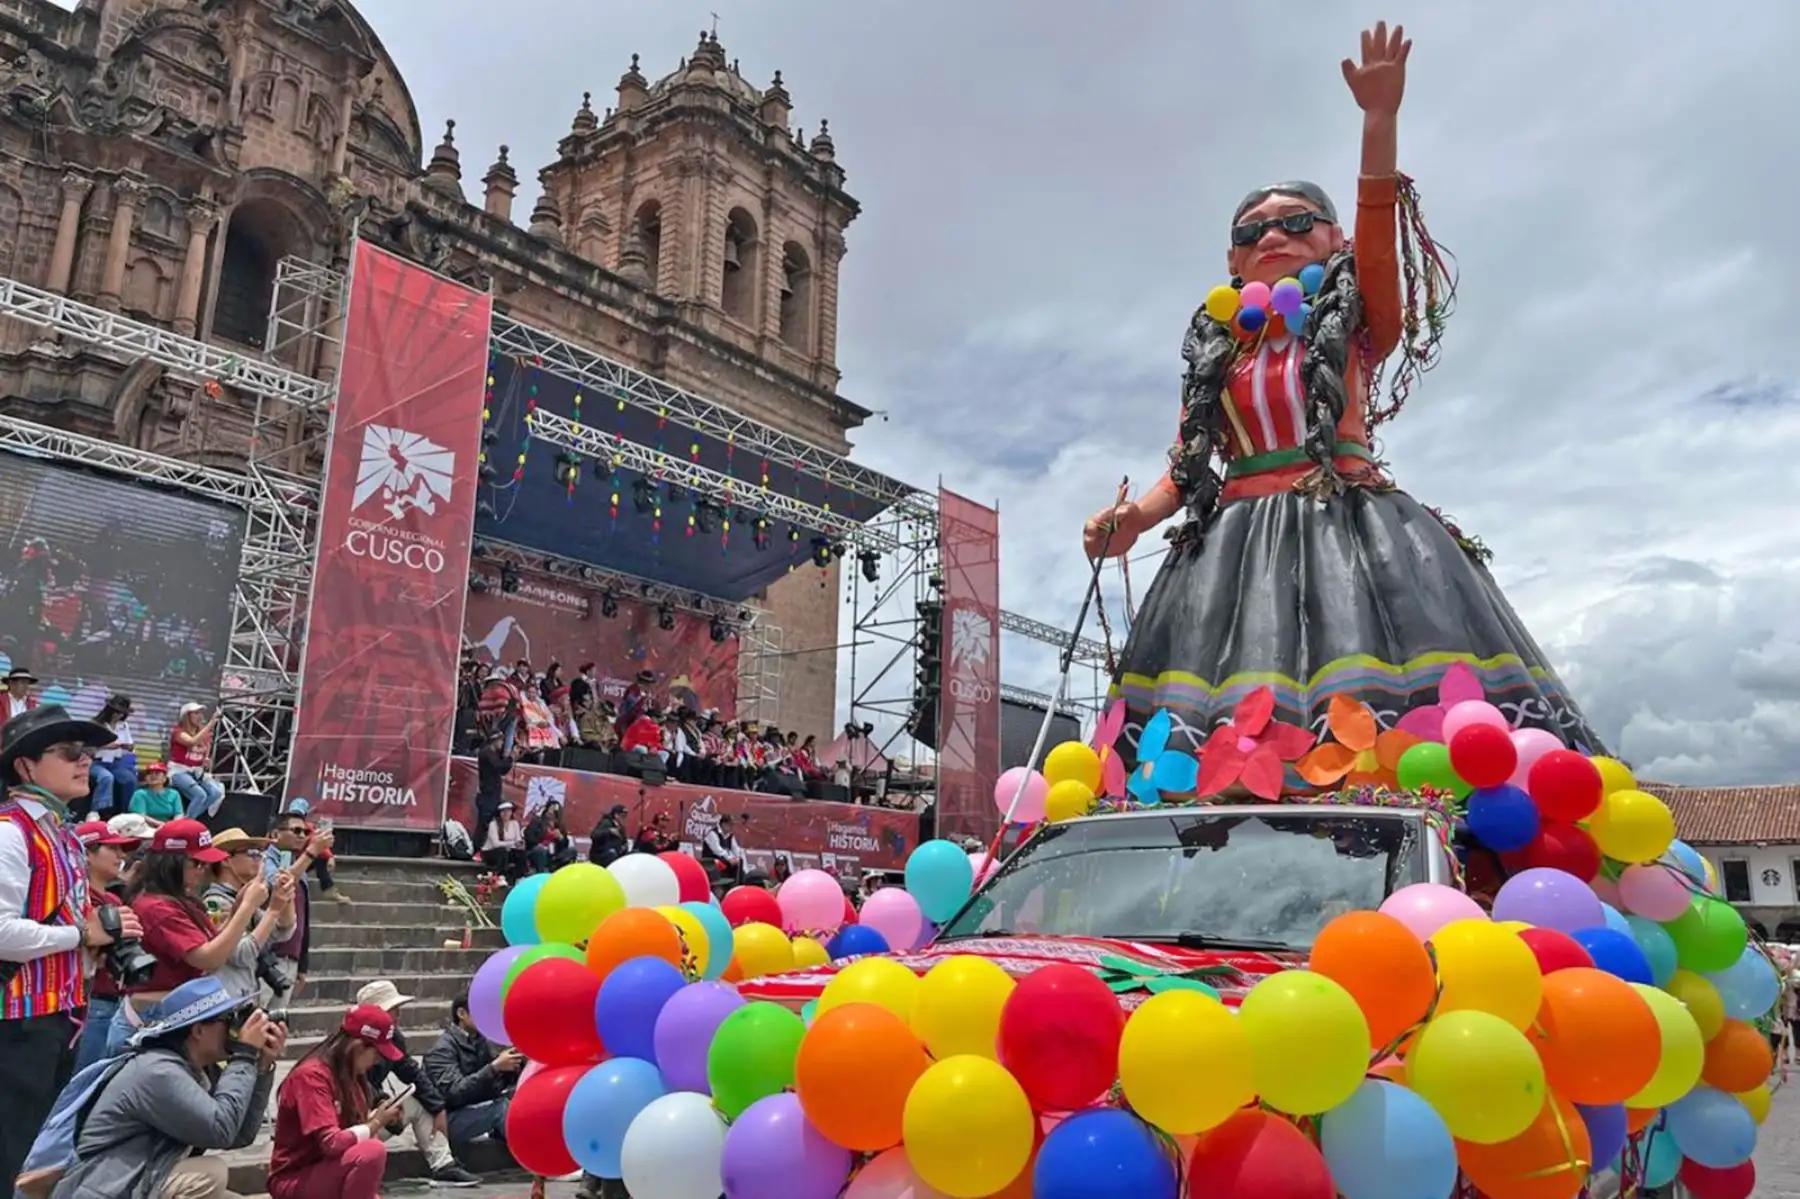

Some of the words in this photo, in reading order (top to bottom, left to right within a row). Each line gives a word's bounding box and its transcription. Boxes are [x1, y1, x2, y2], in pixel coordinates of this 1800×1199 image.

[347, 530, 444, 573] CUSCO
[517, 584, 588, 608] AMPEONES
[949, 678, 992, 704] CUSCO
[323, 762, 394, 787] Hagamos
[322, 780, 417, 806] HISTORIA
[829, 834, 880, 852] HISTORIA
